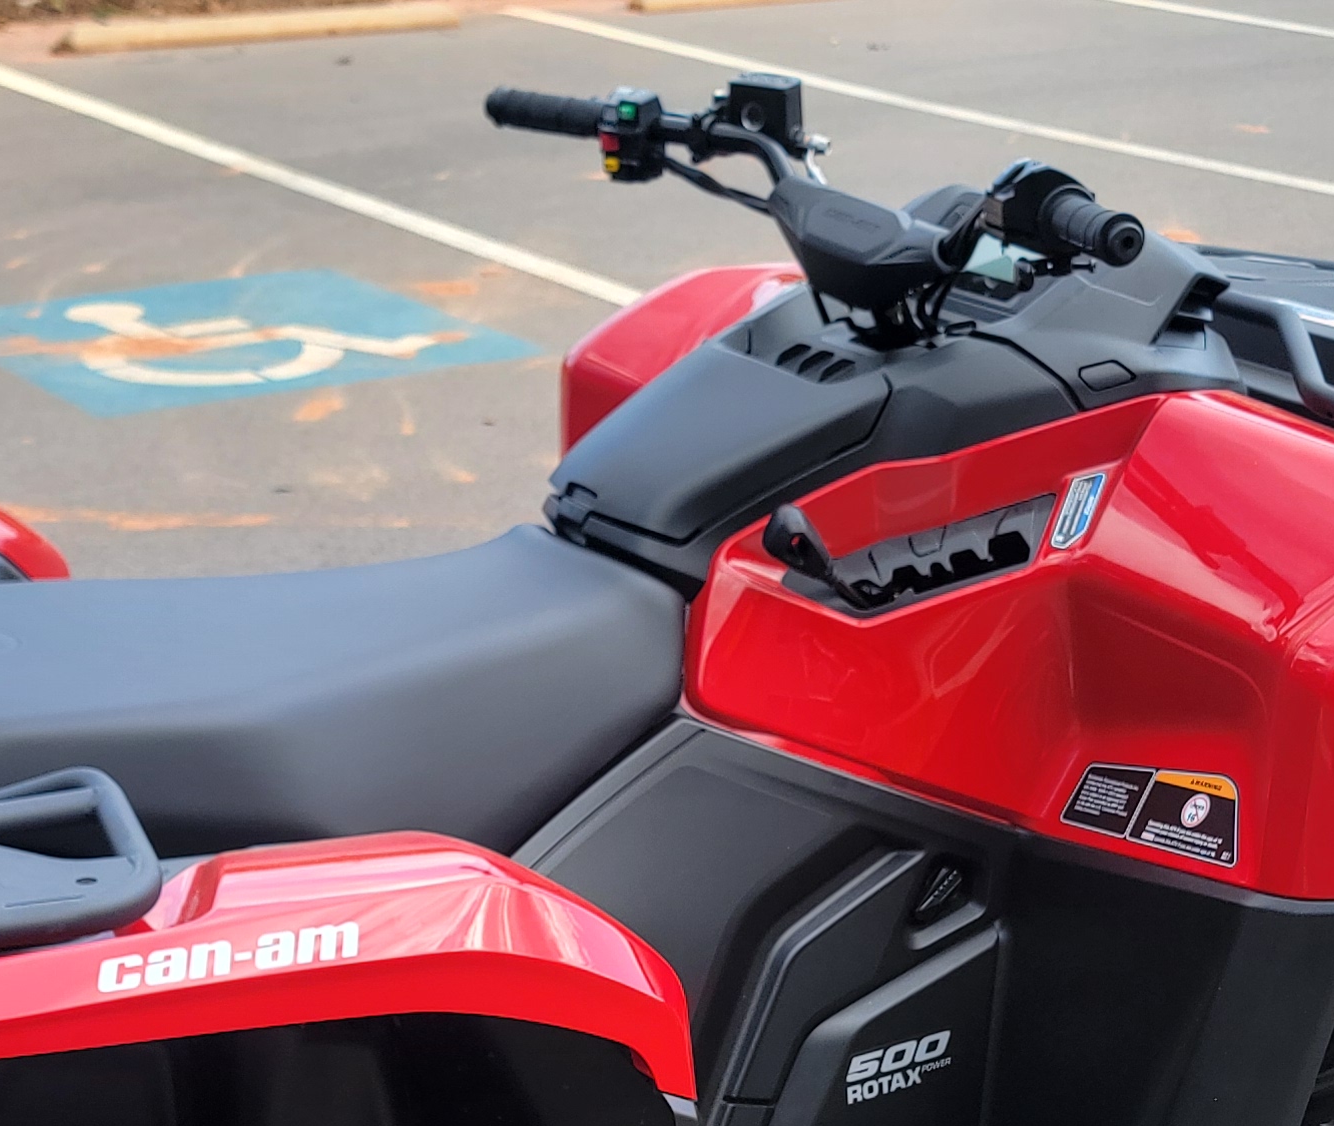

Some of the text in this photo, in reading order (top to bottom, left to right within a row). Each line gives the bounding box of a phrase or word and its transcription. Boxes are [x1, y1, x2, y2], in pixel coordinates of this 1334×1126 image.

[97, 921, 360, 993] can-am
[845, 1029, 952, 1083] 500
[920, 1056, 952, 1074] POWER
[846, 1065, 922, 1105] ROTAX
